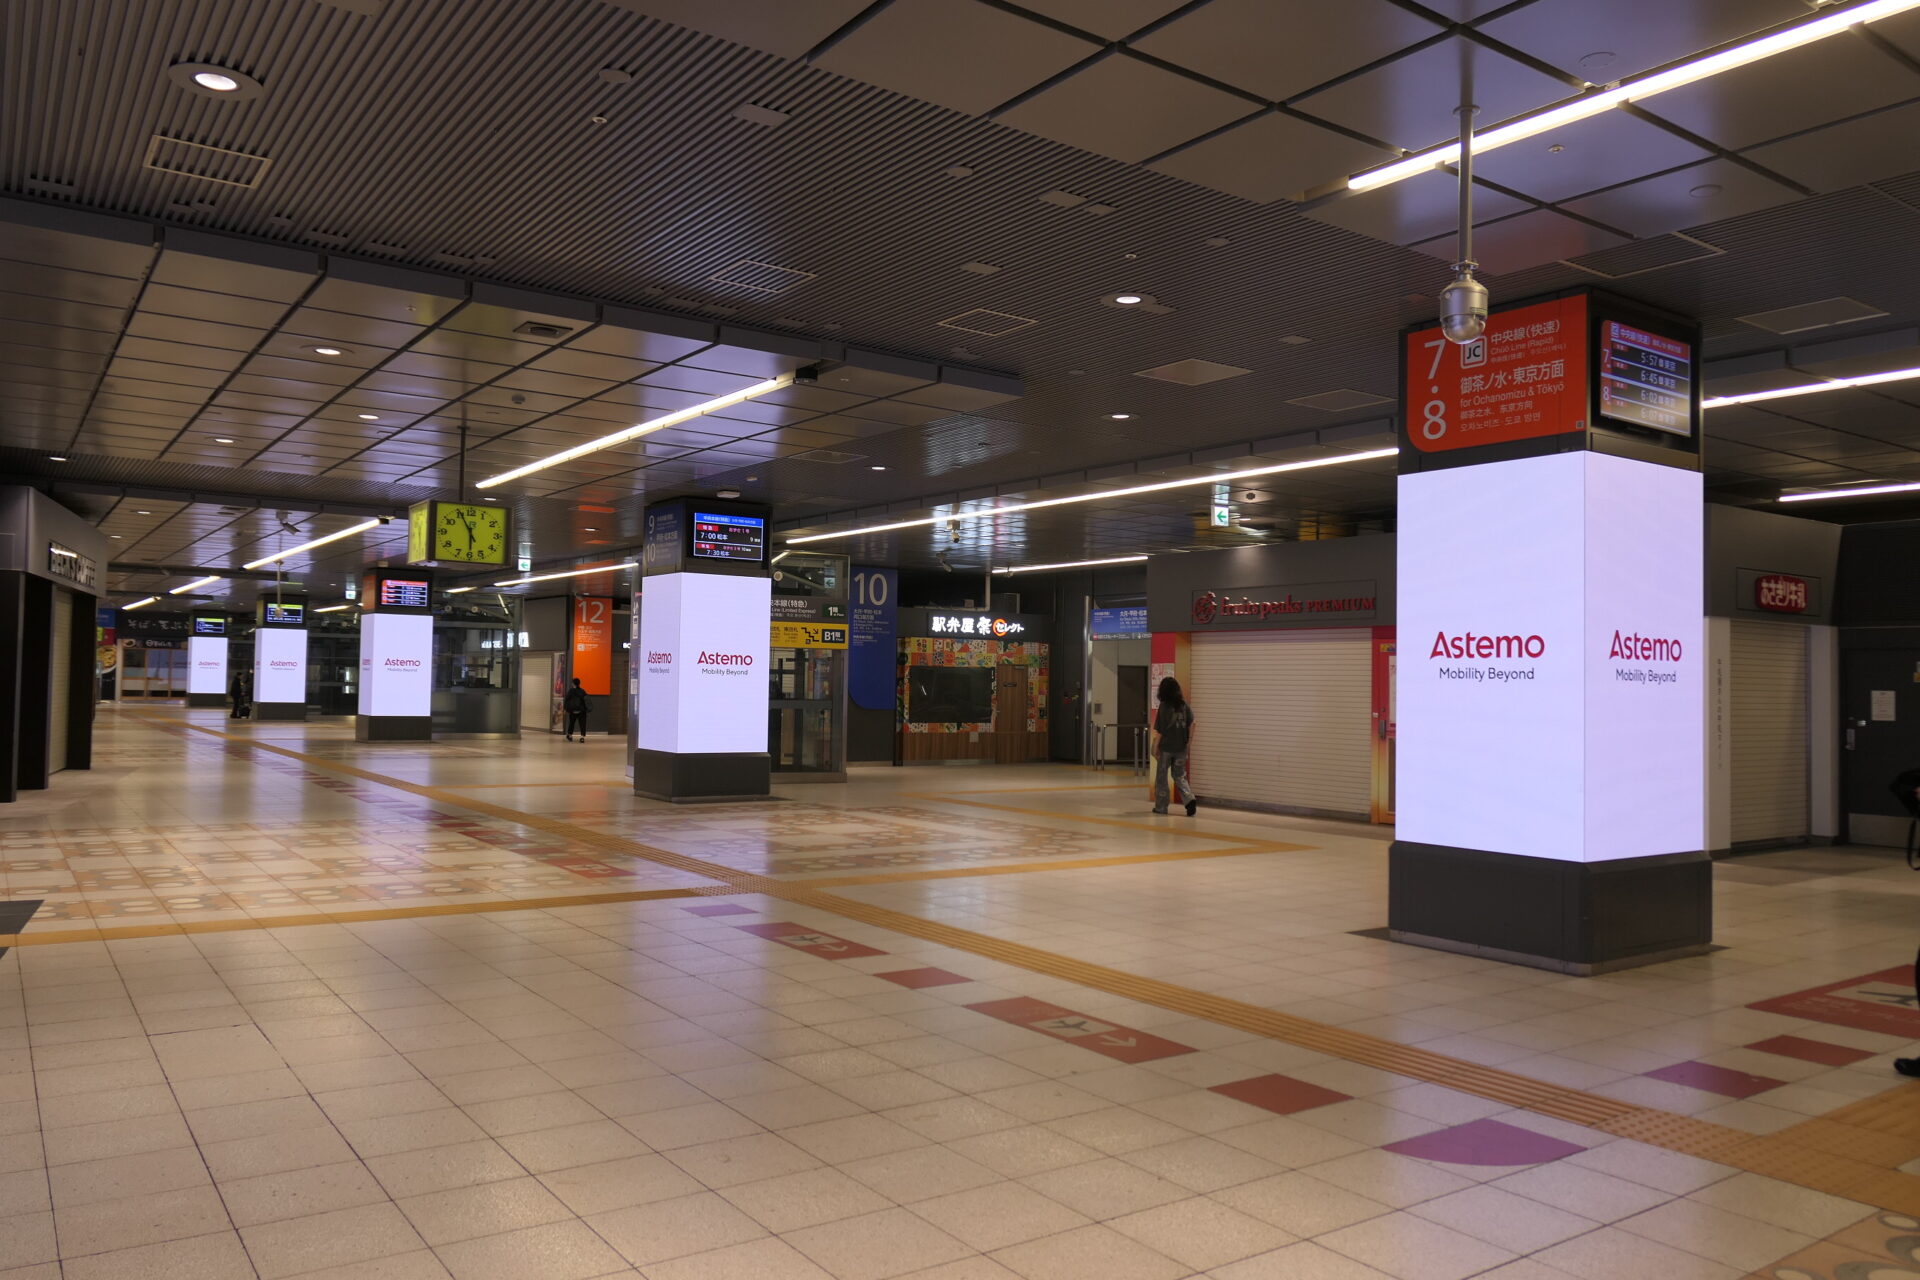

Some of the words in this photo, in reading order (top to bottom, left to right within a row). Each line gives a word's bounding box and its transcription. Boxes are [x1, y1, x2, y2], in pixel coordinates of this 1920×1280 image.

[1491, 320, 1560, 344] 中央線(快速)
[1467, 346, 1481, 359] JC
[1511, 342, 1526, 350] Line
[1424, 339, 1446, 380] 7
[1603, 349, 1610, 363] 7
[1641, 353, 1658, 367] 5:57
[1460, 360, 1564, 395] 御茶ノ水・東京方面
[1641, 372, 1658, 384] 6:45
[1460, 398, 1471, 408] for
[1473, 390, 1526, 406] Ochanomizu
[1528, 386, 1535, 396] &
[1603, 387, 1609, 400] 8
[1423, 400, 1447, 440] 8
[649, 515, 654, 534] 9
[647, 544, 656, 562] 10
[855, 573, 888, 606] 10
[579, 601, 604, 623] 12
[1220, 596, 1258, 616] fruits
[1260, 593, 1302, 619] peaks
[1306, 598, 1376, 612] PREMIUM
[932, 616, 975, 633] 駅弁屋
[996, 622, 1024, 633] セレクト
[1430, 631, 1545, 660] Astemo
[1609, 630, 1682, 662] Astemo
[384, 658, 421, 667] Astemo
[647, 650, 672, 665] Astemo
[697, 650, 753, 666] Astemo
[702, 668, 725, 676] Mobility
[726, 668, 748, 676] Beyond
[1439, 668, 1485, 683] Mobility
[1488, 668, 1535, 683] Beyond
[1616, 669, 1646, 684] Mobility
[1648, 670, 1676, 686] Beyond
